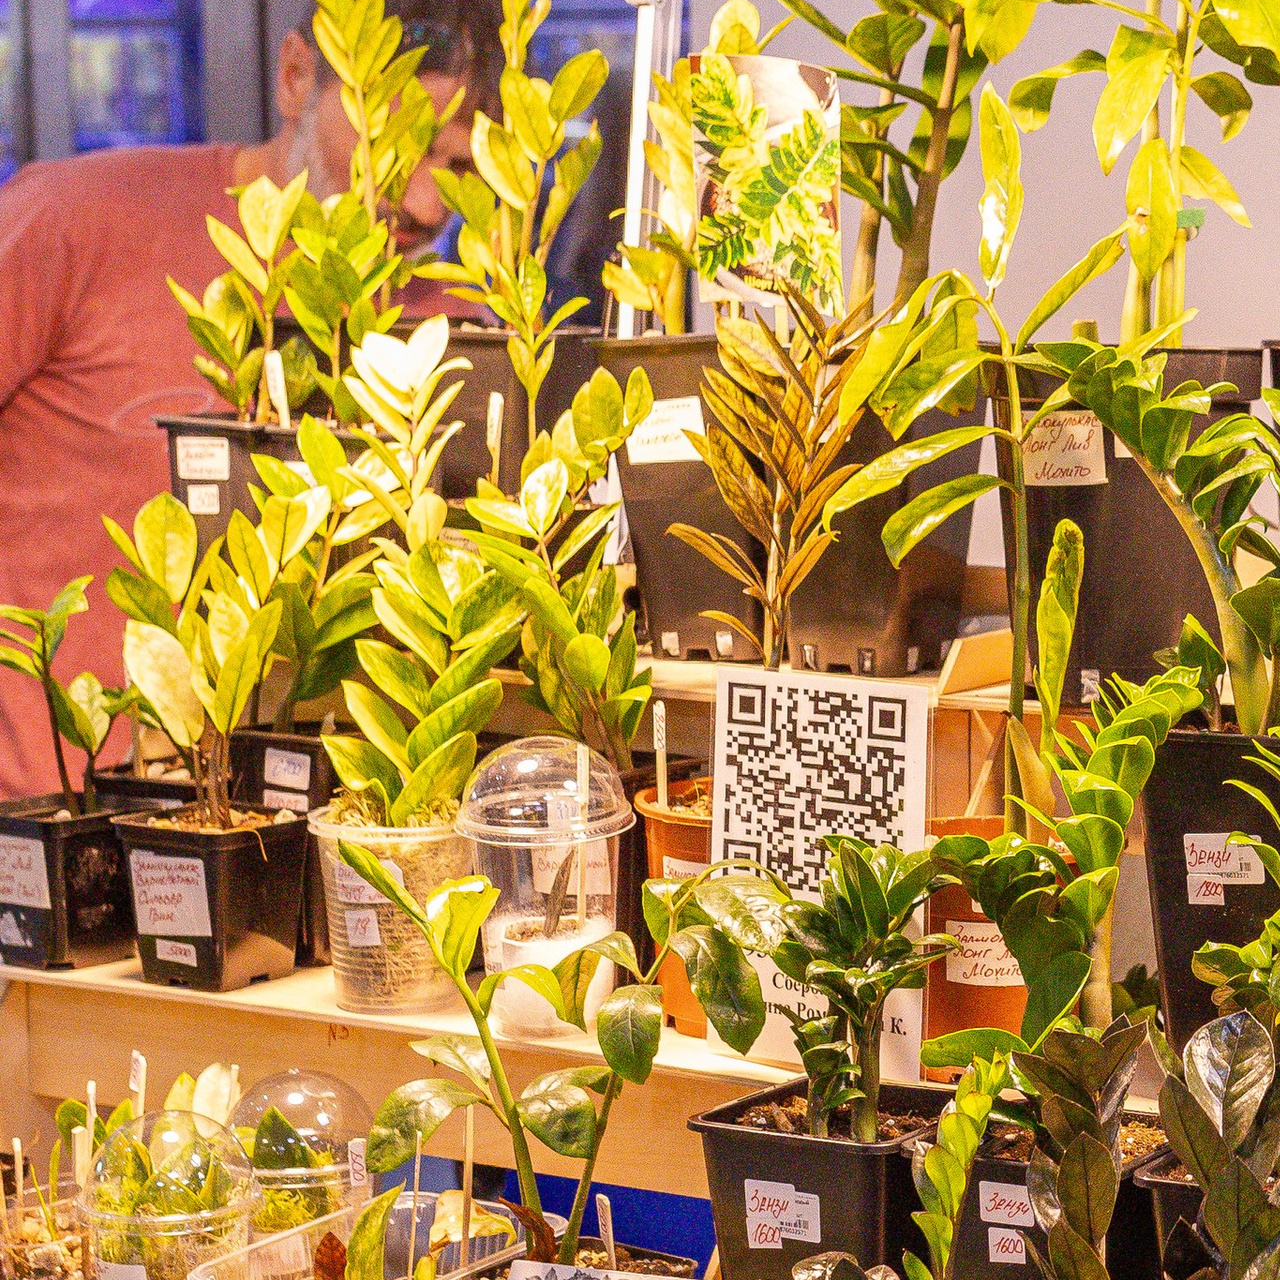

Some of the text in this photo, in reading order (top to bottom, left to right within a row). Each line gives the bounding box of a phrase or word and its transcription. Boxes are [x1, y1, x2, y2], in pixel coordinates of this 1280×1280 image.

[1188, 843, 1231, 869] Зензи
[1195, 880, 1223, 897] 1800
[891, 1016, 907, 1037] К.
[749, 1188, 790, 1219] Зензи
[985, 1192, 1030, 1218] Зензи
[752, 1222, 781, 1245] 1600
[993, 1236, 1024, 1254] 1600
